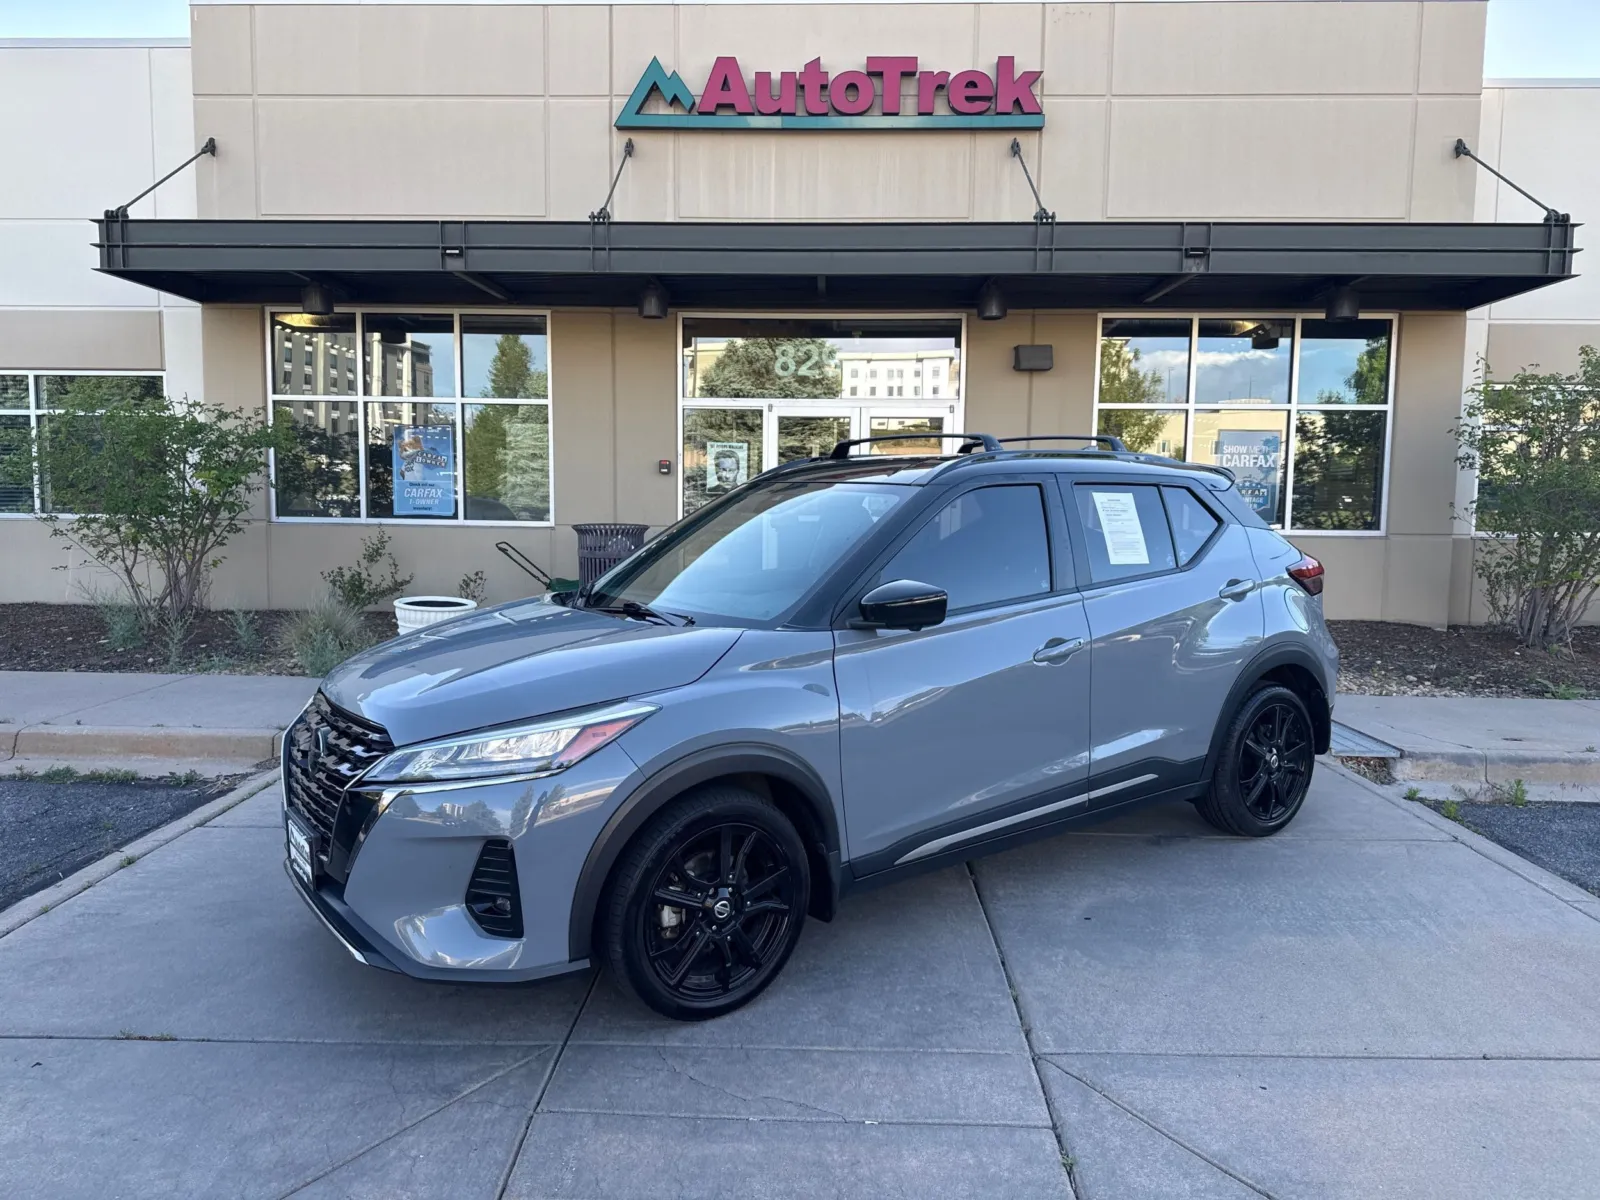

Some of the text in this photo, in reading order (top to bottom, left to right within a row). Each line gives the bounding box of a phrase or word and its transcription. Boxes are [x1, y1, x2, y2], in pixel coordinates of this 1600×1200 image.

[697, 56, 1043, 115] AutoTrek
[1223, 445, 1247, 454] SHOW
[1249, 445, 1260, 454] ME
[1222, 454, 1275, 468] CARFAX
[404, 488, 443, 498] CARFAX
[1241, 488, 1267, 496] RFAX
